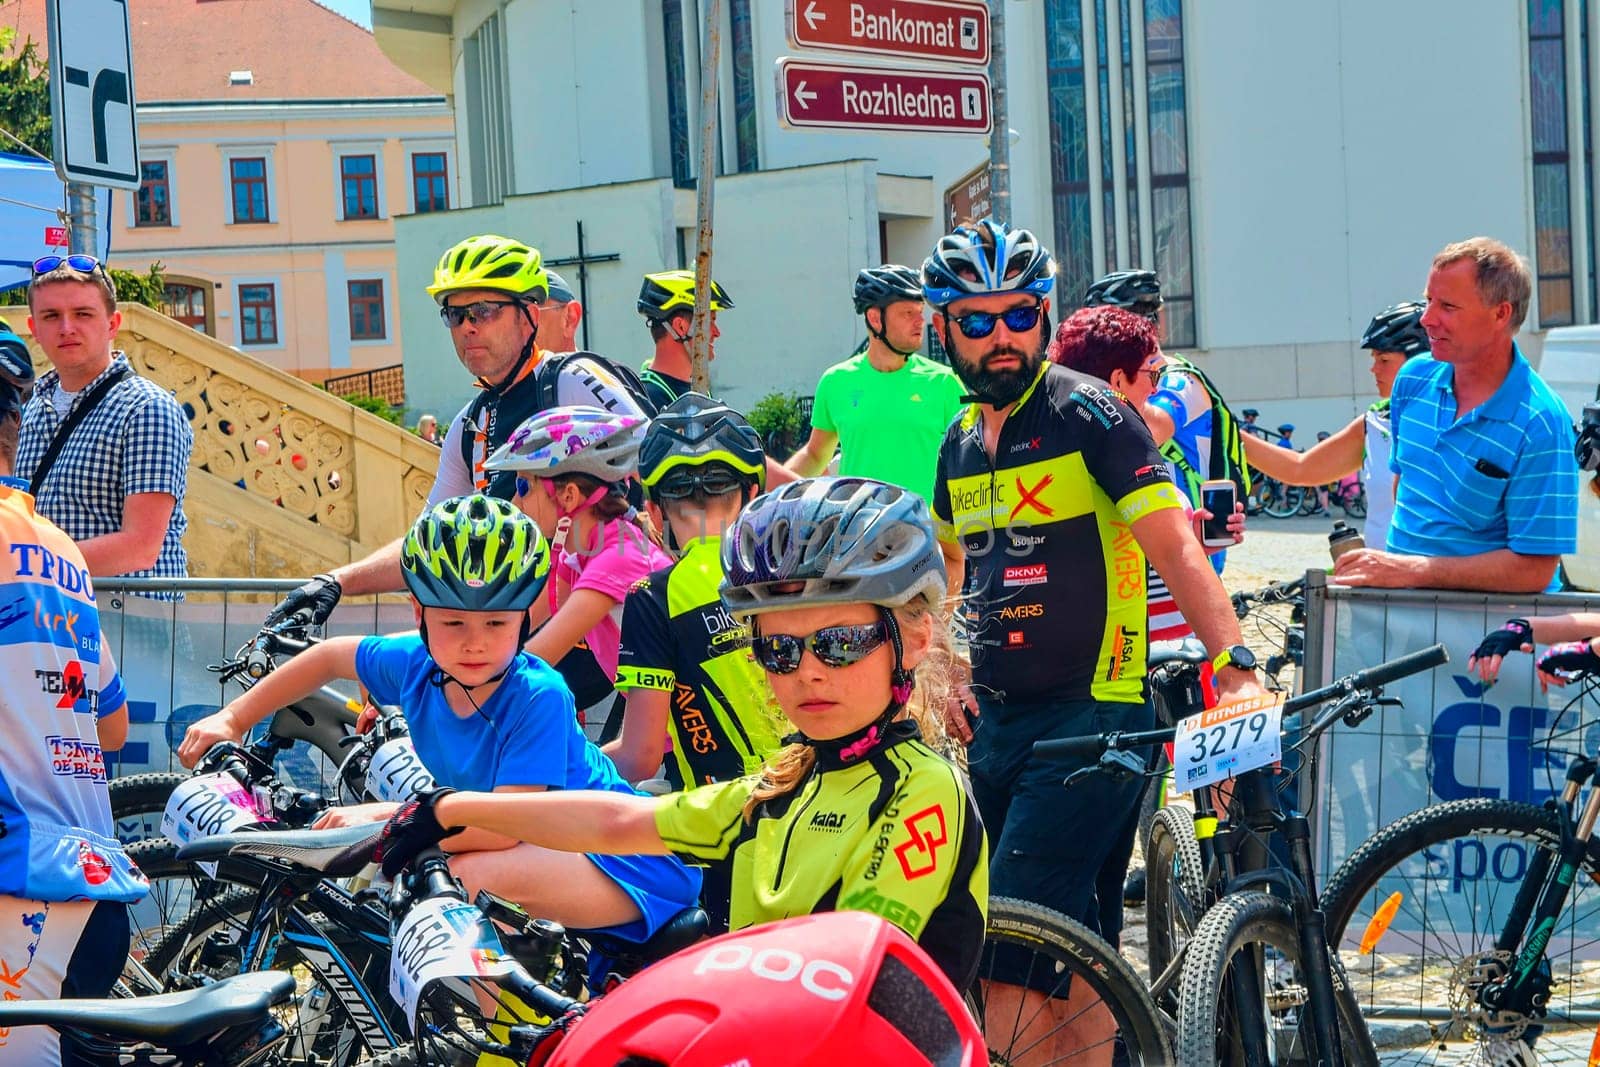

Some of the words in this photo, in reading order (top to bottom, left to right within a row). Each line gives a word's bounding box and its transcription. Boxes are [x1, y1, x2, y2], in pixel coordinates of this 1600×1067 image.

[850, 3, 954, 48] Bankomat
[842, 79, 956, 119] Rozhledna
[1190, 713, 1268, 763] 3279
[177, 784, 236, 836] 7208
